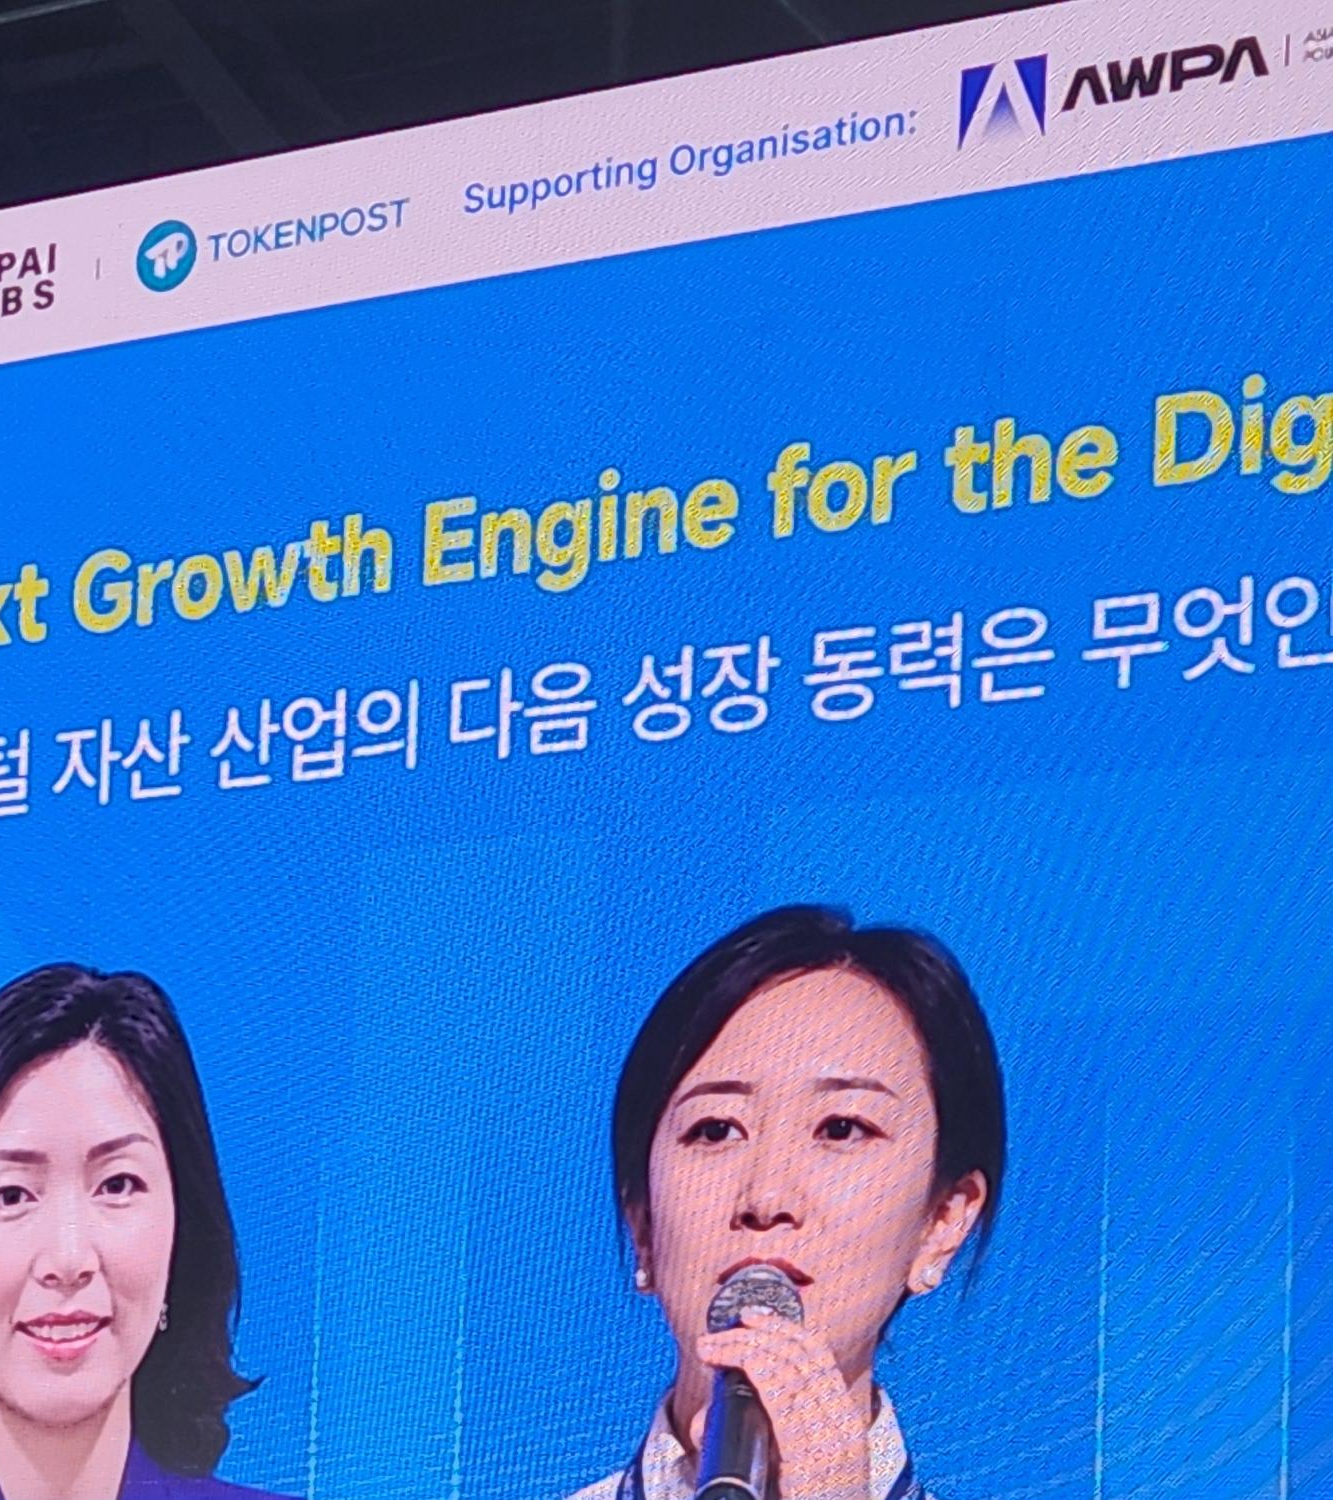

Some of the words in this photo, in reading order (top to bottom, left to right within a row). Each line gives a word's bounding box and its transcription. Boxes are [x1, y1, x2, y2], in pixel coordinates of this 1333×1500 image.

[1060, 35, 1270, 113] AWPA
[463, 152, 658, 216] Supporting
[668, 106, 919, 179] Organisation:
[206, 198, 410, 263] TOKENPOST
[73, 511, 393, 636] Growth
[423, 468, 740, 593] Engine
[767, 442, 918, 538] for
[944, 417, 1119, 517] the
[1153, 373, 1333, 495] Dig
[52, 710, 191, 808] 자산
[210, 677, 421, 791] 산업의
[448, 660, 598, 760] 다음
[621, 634, 781, 744] 성장
[802, 604, 1055, 722] 동력은
[1081, 573, 1333, 690] 무엇인
